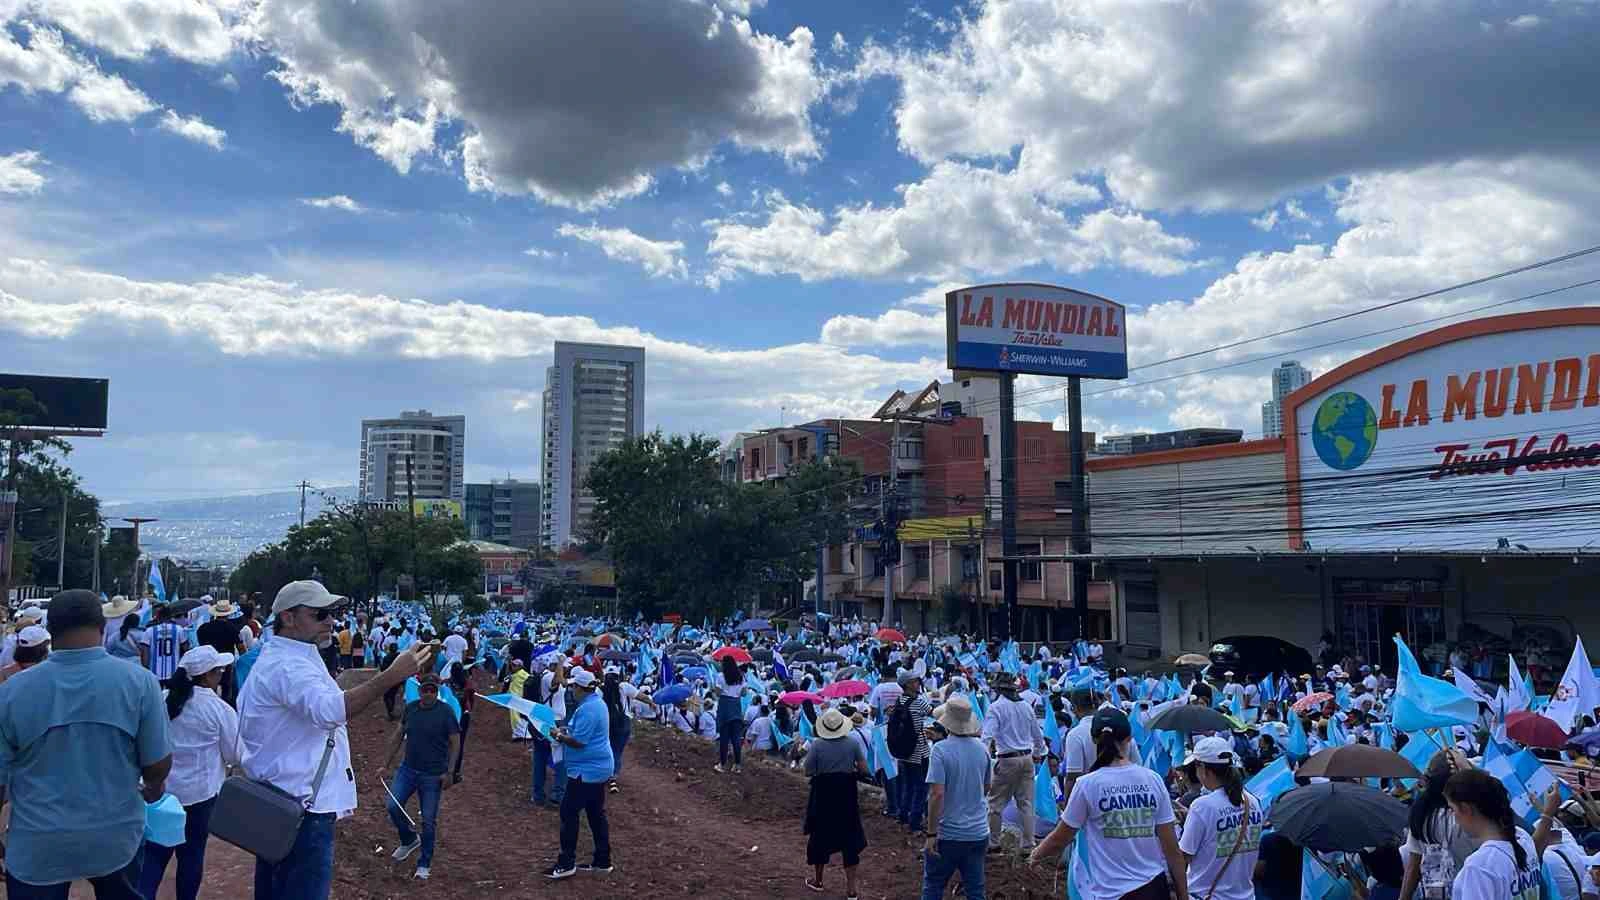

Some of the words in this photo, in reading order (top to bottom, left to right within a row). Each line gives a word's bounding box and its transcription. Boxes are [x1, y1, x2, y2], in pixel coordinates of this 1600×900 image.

[960, 295, 993, 328] LA
[1002, 299, 1120, 336] MUNDIAL
[1010, 351, 1088, 369] SHERWIN-WILLIAMS
[1379, 379, 1429, 430] LA
[158, 638, 173, 656] 10
[1103, 784, 1152, 796] HONDURAS
[1098, 793, 1157, 812] CAMINA
[1216, 811, 1262, 831] CAMNA
